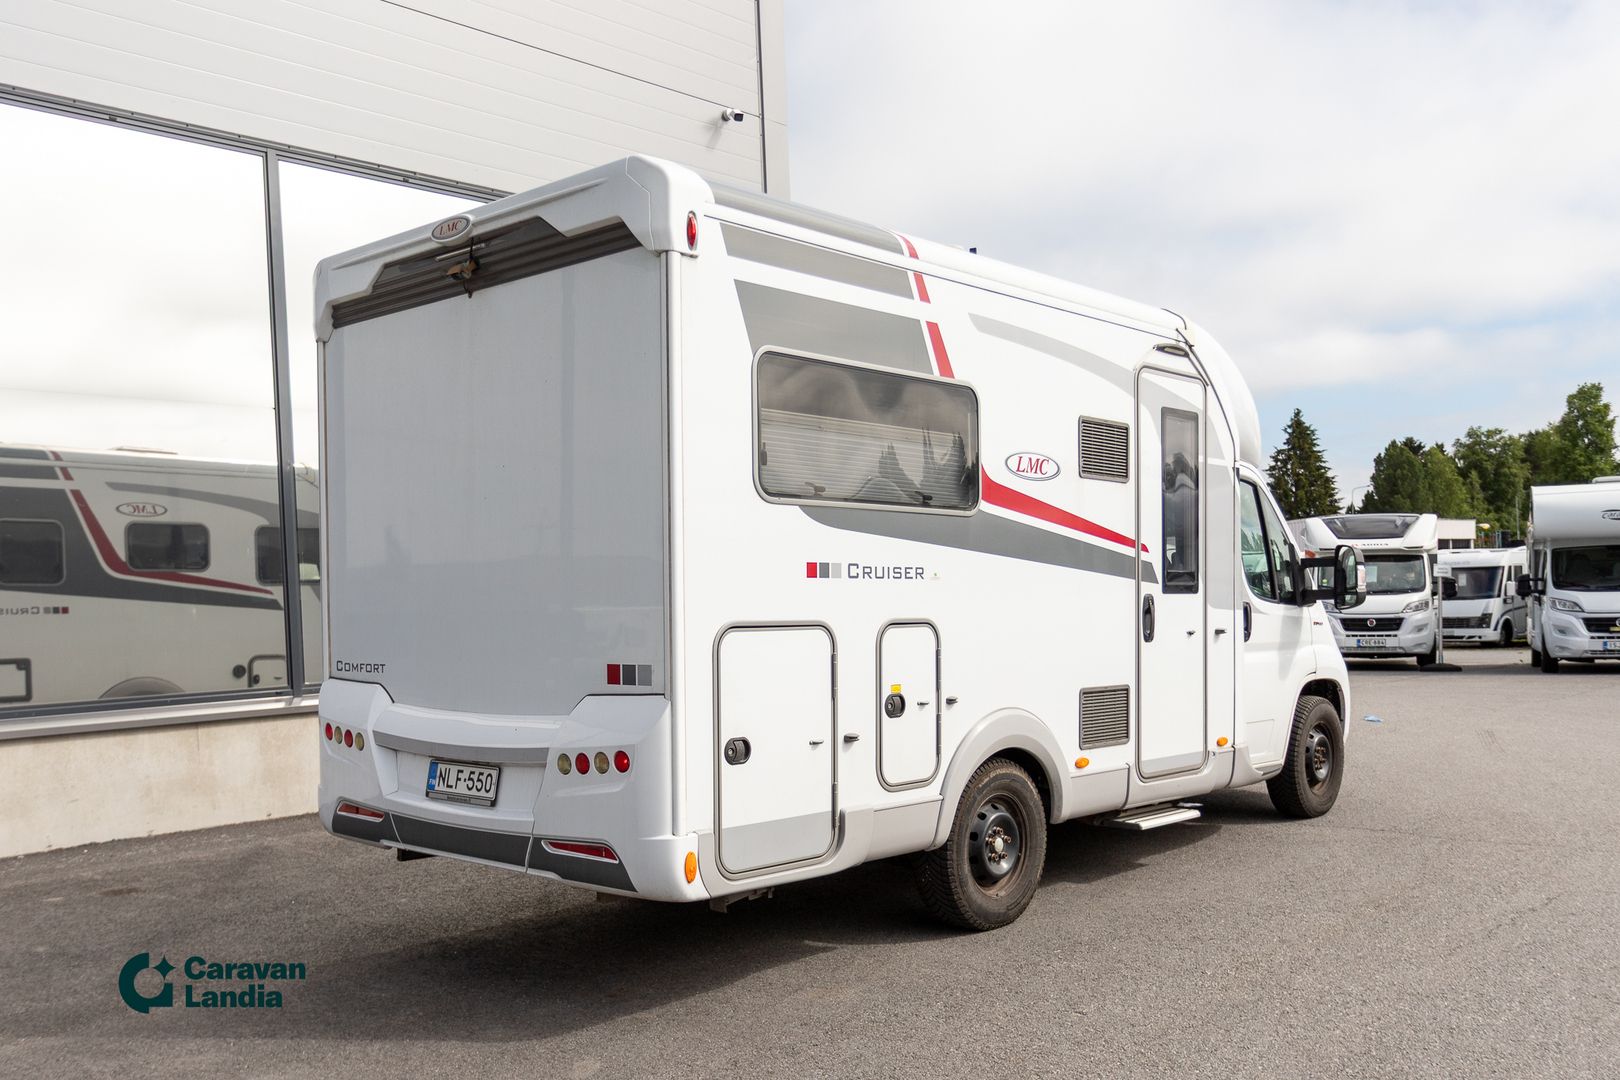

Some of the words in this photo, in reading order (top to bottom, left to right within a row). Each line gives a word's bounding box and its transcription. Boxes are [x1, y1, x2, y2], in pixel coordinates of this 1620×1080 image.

[439, 220, 462, 236] LMC
[1014, 455, 1049, 477] LMC
[847, 562, 925, 580] CRUISER
[336, 660, 387, 674] COMFORT
[437, 767, 494, 794] NLF-550
